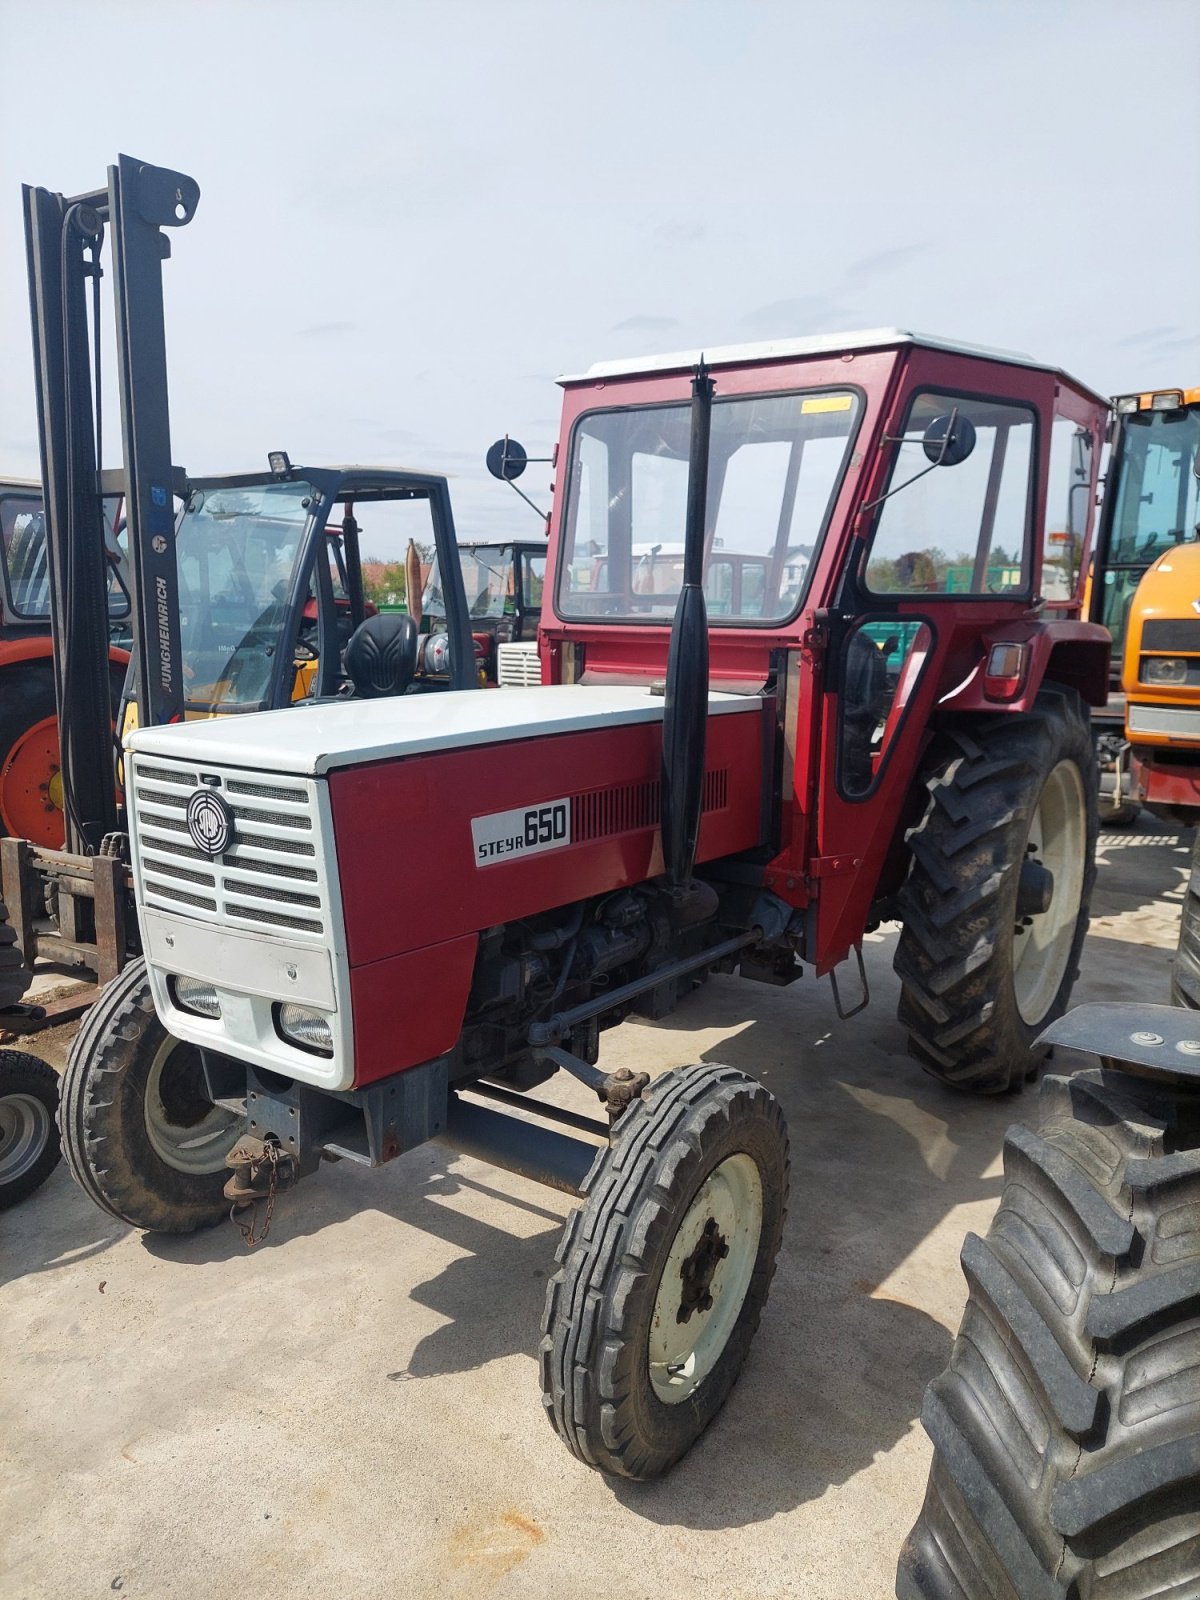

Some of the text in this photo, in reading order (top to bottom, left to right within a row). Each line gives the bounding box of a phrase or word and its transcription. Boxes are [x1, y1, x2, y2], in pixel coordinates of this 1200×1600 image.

[156, 576, 172, 693] JUNGHEINRICH
[478, 804, 566, 859] STEYR 650
